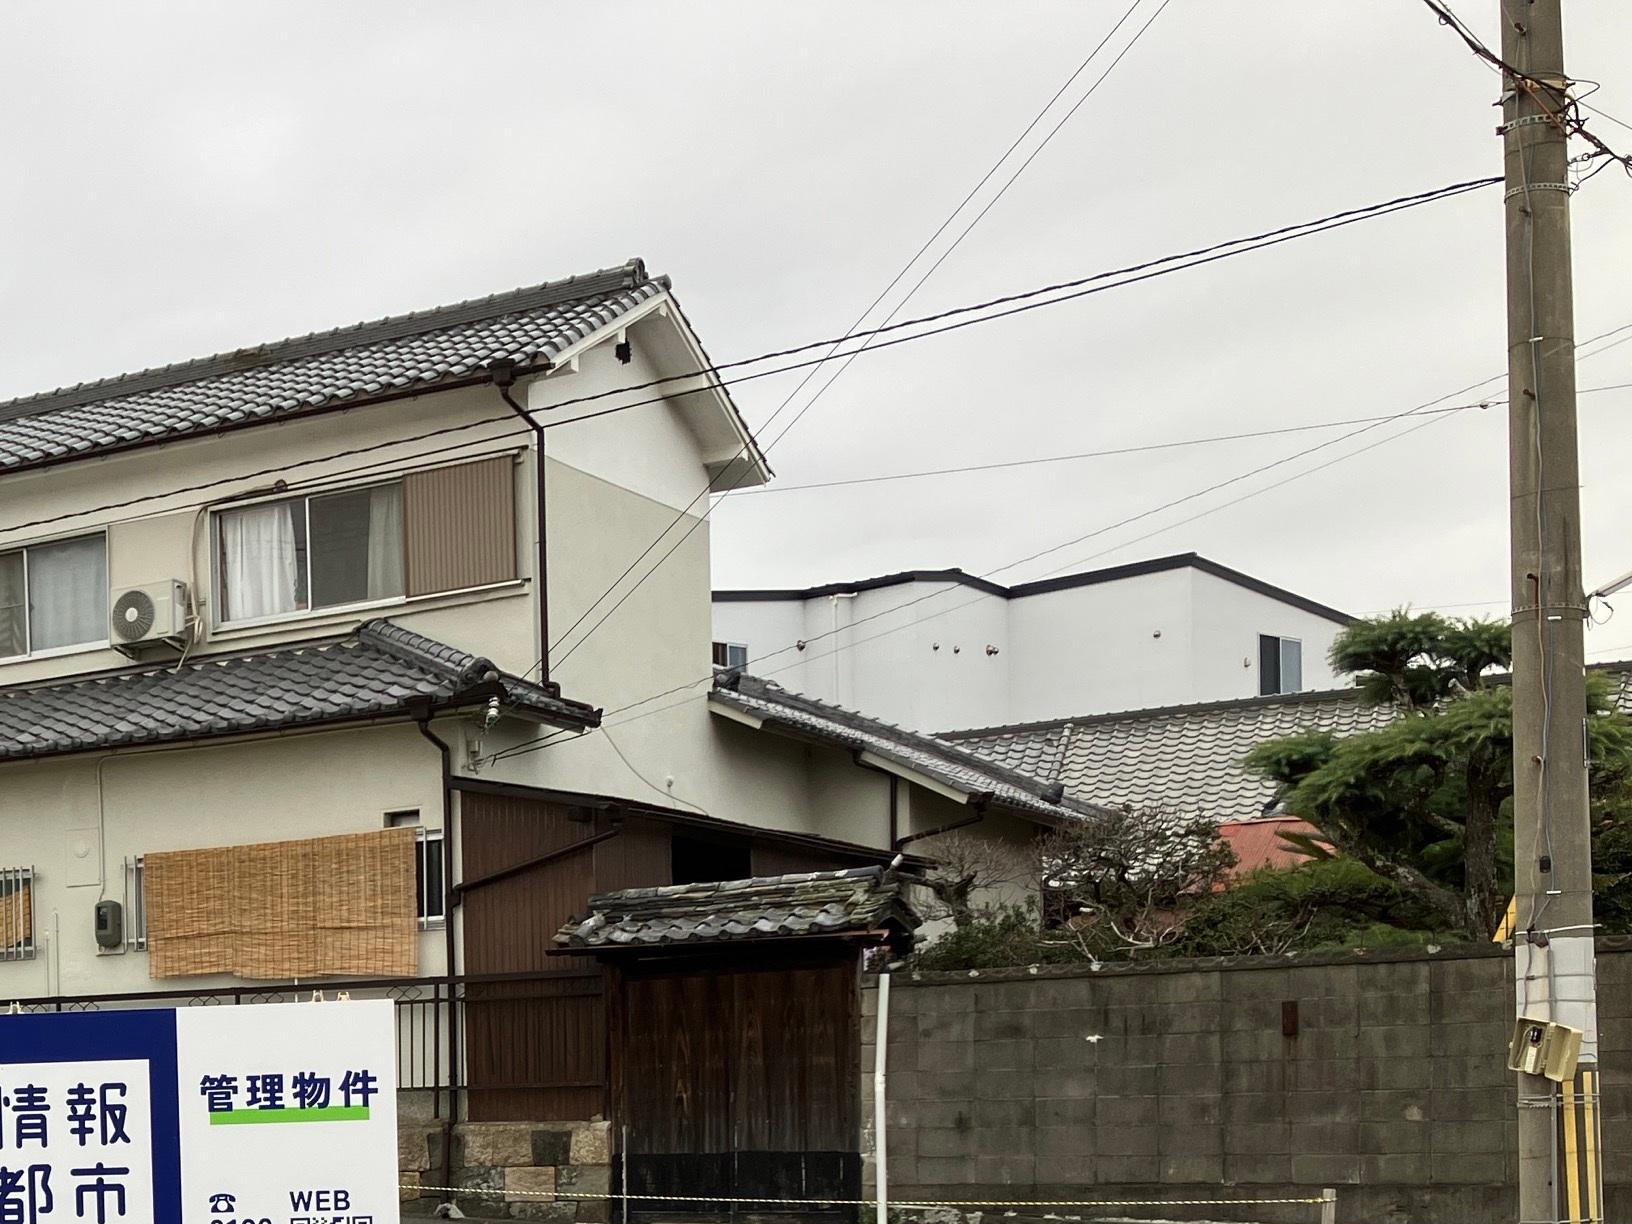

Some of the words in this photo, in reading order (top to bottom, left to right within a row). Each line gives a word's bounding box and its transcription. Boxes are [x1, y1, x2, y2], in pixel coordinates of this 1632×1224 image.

[200, 1069, 379, 1112] 管理物件
[289, 1190, 351, 1212] WEB
